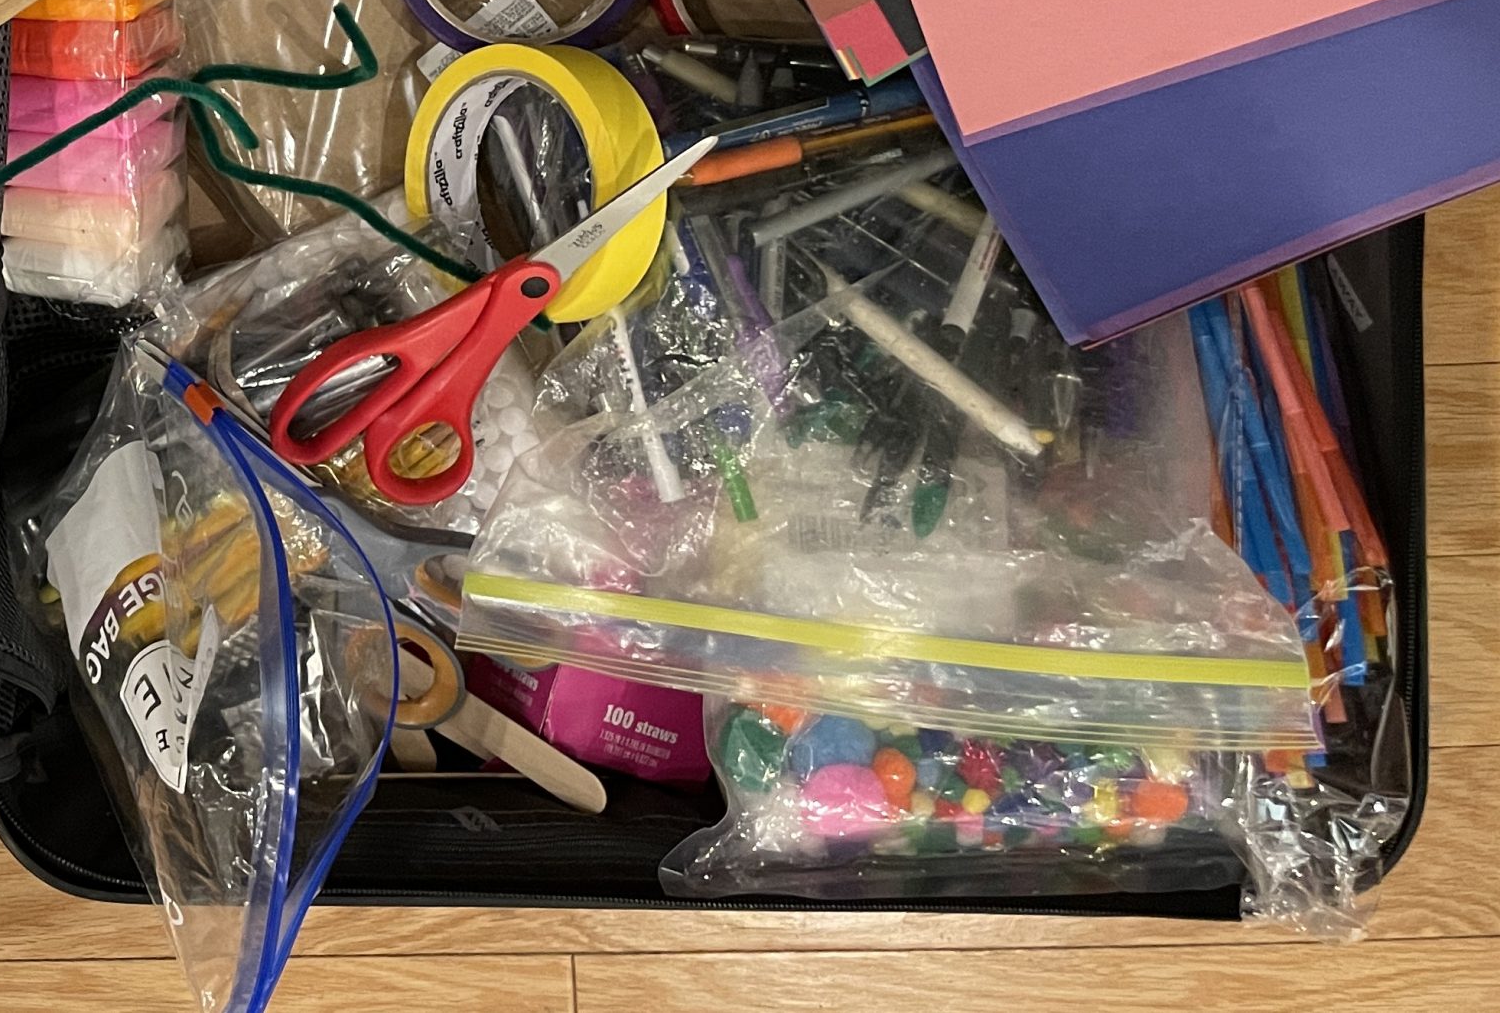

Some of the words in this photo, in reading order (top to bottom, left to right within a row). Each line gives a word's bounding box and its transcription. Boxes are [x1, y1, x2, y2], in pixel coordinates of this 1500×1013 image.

[86, 608, 121, 685] BAG
[603, 703, 636, 730] 100
[634, 719, 679, 745] straws
